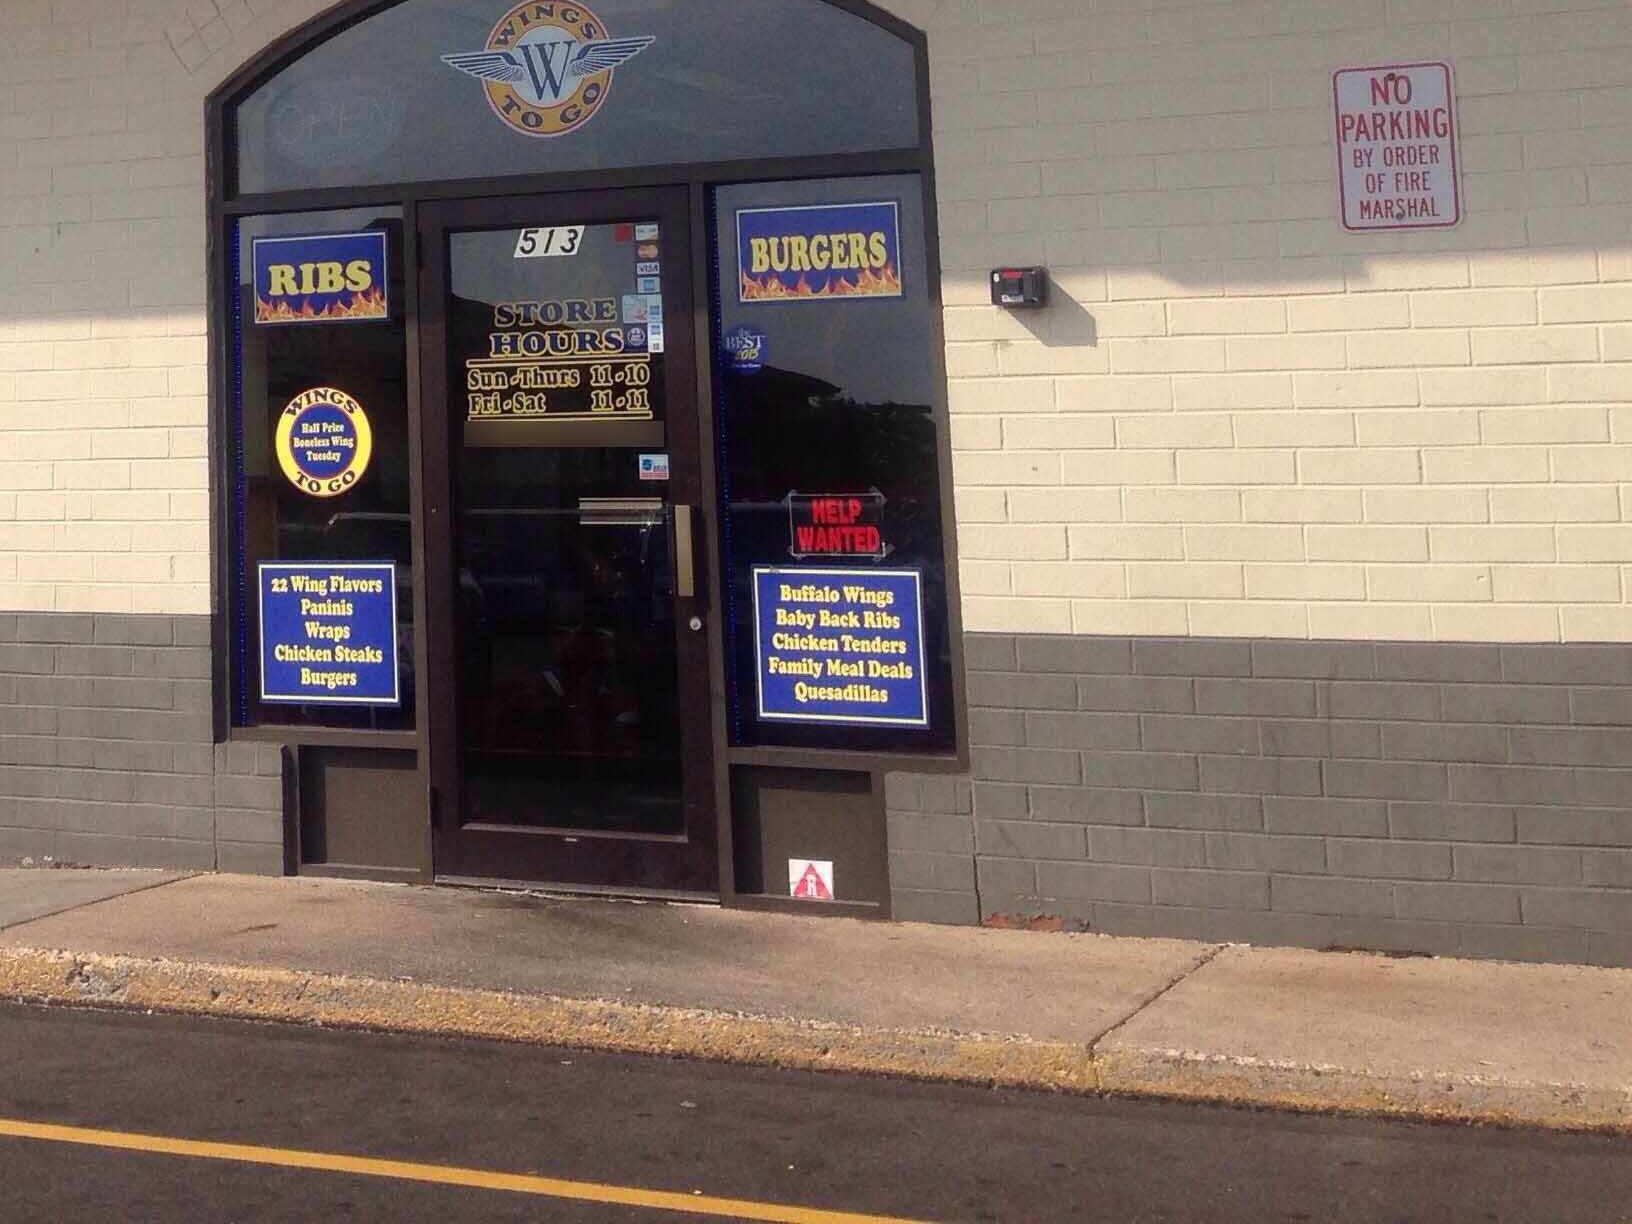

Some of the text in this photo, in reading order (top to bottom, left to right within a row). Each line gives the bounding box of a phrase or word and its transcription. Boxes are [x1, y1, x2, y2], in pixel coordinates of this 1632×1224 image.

[495, 4, 597, 45] WINGS
[517, 40, 576, 100] W
[1370, 75, 1412, 106] NO
[501, 82, 601, 128] TO GO
[1341, 108, 1448, 143] PARKING
[1353, 145, 1440, 168] BY ORDER
[1365, 171, 1431, 193] OF FIRE
[1359, 197, 1440, 220] MARSHAL
[519, 228, 579, 255] 513
[751, 231, 887, 272] BURGERS
[268, 260, 371, 296] RIBS
[638, 264, 658, 273] VISA
[495, 298, 617, 327] STORE
[490, 328, 624, 357] HOURS
[286, 389, 357, 416] WINGS
[301, 422, 344, 433] Half Price
[293, 436, 354, 448] Boneless Wing
[306, 450, 342, 462] Tuesday
[295, 470, 355, 492] TO GO
[811, 497, 862, 524] HELP
[797, 525, 880, 552] WANTED
[271, 576, 382, 596] 22 Wing Flavors
[780, 585, 893, 607] Buffalo Wings
[301, 599, 352, 615] Paninis
[776, 609, 900, 629] Baby Back Ribs
[305, 622, 350, 642] Wraps
[772, 633, 907, 653] Chicken Tenders
[274, 644, 382, 662] Chicken Steaks
[301, 667, 356, 688] Burgers
[768, 657, 912, 679] Family Meal Deals
[795, 682, 888, 702] Quesadillas
